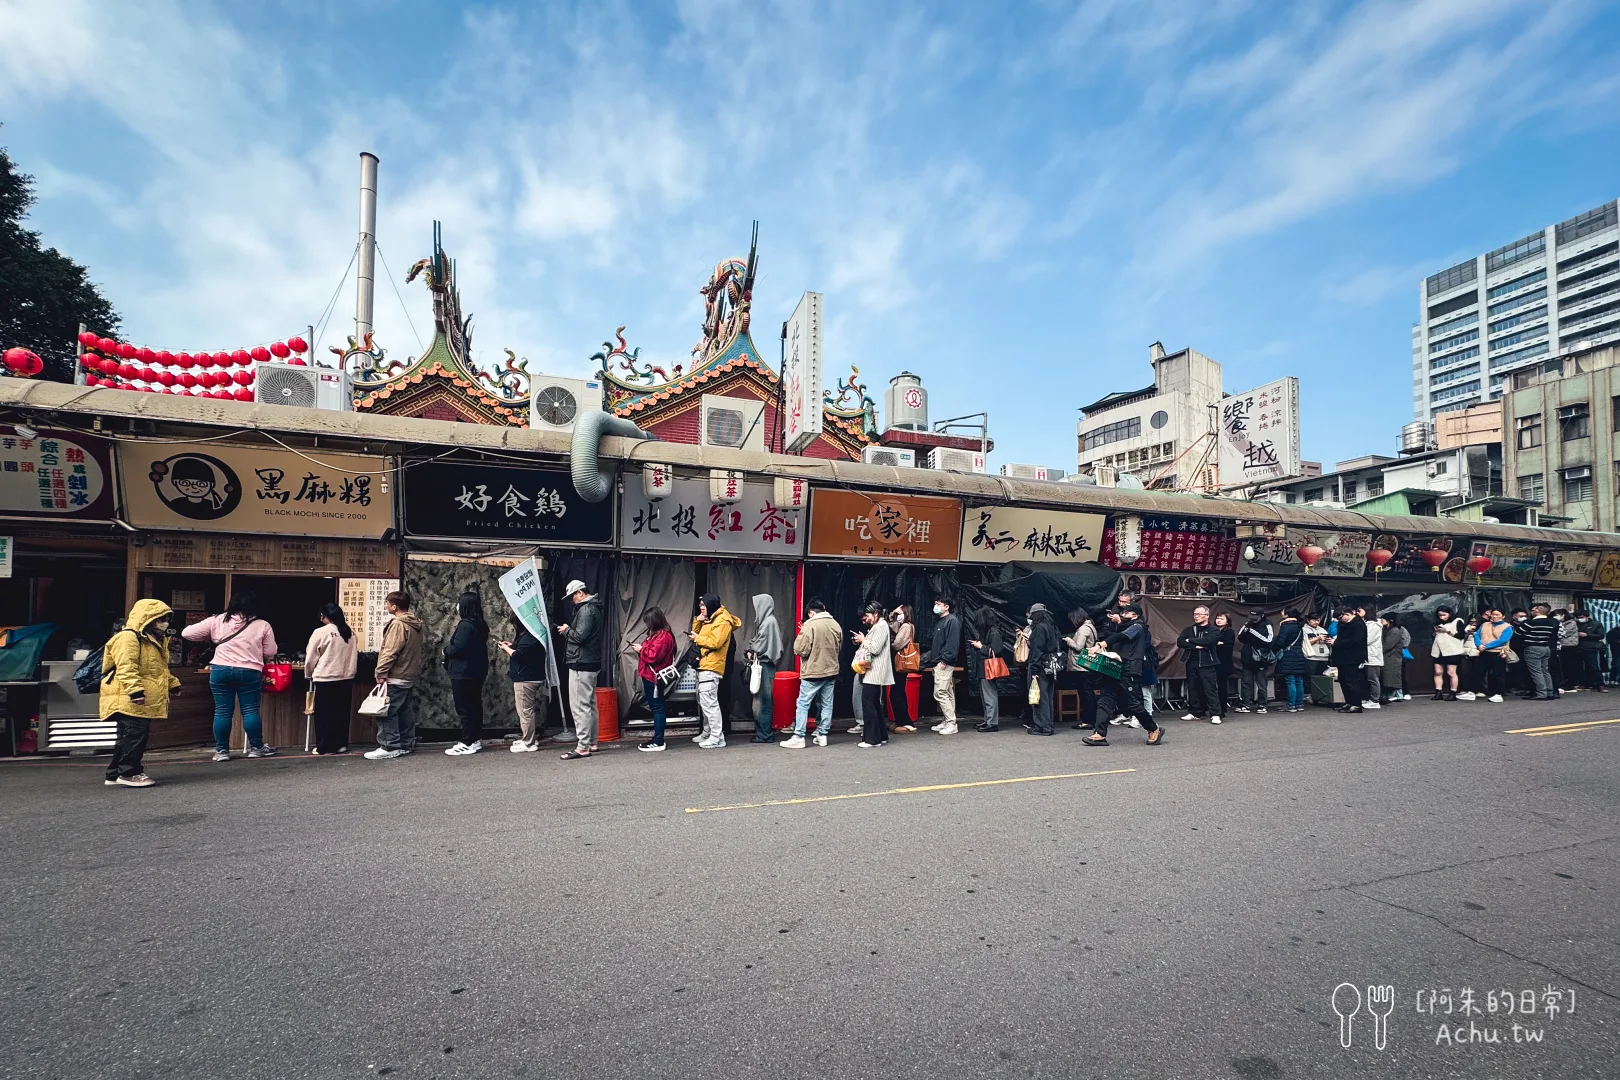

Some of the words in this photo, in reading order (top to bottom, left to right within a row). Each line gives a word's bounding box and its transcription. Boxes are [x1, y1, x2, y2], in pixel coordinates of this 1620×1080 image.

[1243, 439, 1279, 471] 越
[254, 468, 372, 507] 黑麻糬
[264, 508, 291, 516] BLACK
[293, 510, 320, 518] MOCHI
[321, 511, 345, 519] SINCE
[466, 520, 499, 528] Fried
[508, 521, 556, 530] Chicken
[633, 501, 794, 543] 北投紅茶
[844, 506, 931, 544] 吃家裡
